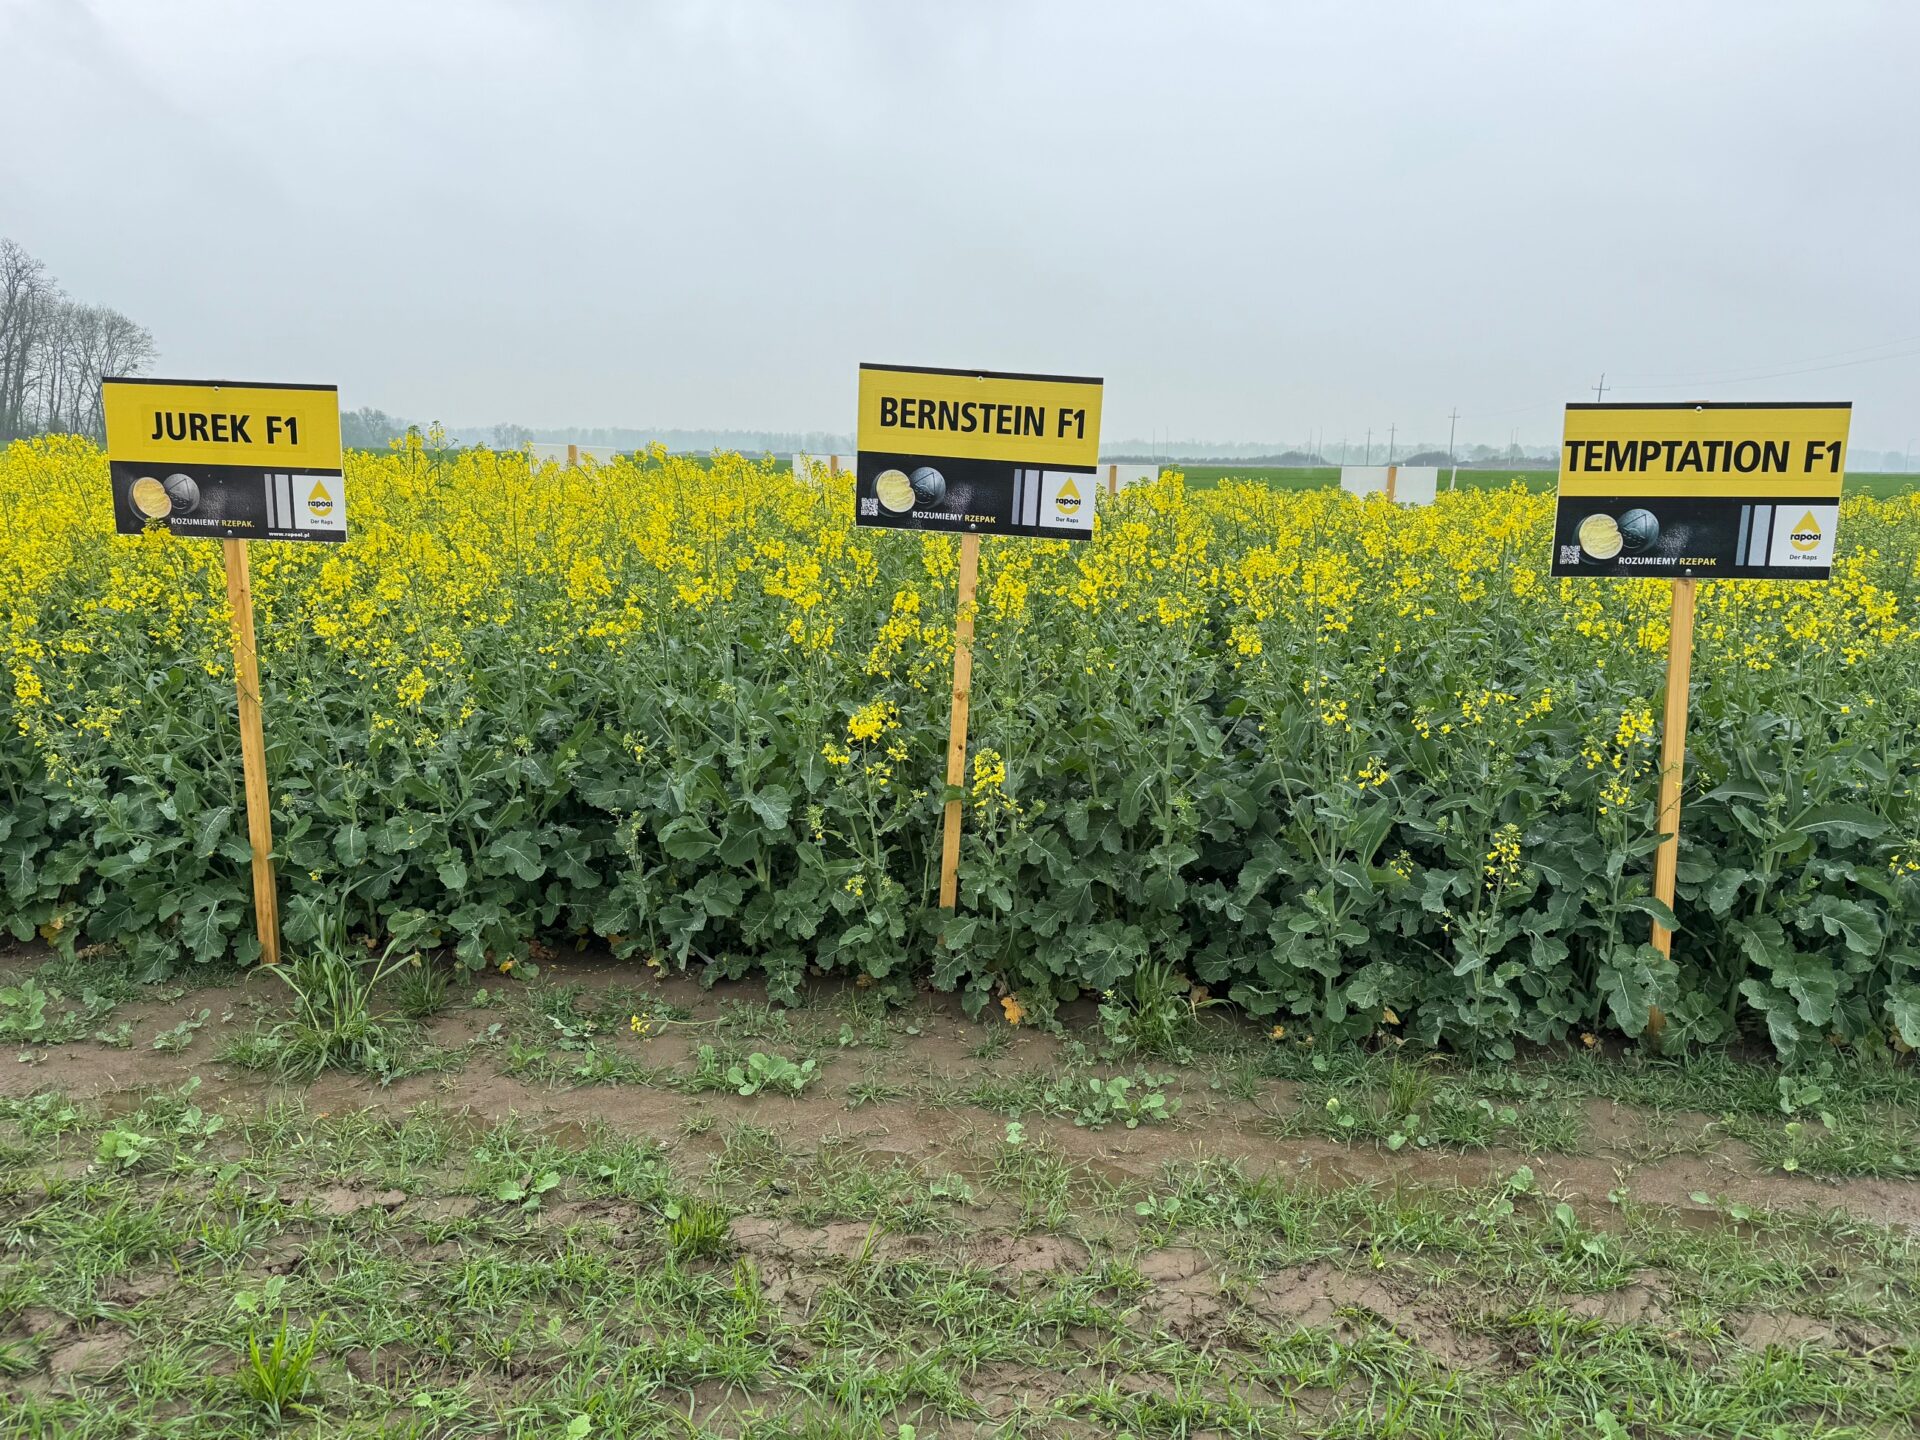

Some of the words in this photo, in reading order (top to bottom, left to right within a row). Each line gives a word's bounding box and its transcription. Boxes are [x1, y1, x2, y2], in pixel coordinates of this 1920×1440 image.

[880, 396, 1045, 437] BERNSTEIN
[1057, 408, 1086, 439] F1
[151, 411, 252, 443] JUREK
[266, 415, 298, 445] F1
[1564, 440, 1790, 473] TEMPTATION
[1803, 440, 1842, 473] F1
[307, 499, 333, 510] rapool
[1055, 497, 1082, 506] rapool
[912, 511, 963, 522] ROZUMIEMY
[964, 514, 996, 523] RZEPAK
[1066, 517, 1079, 525] Raps
[170, 517, 219, 527] ROZUMIEMY
[221, 519, 255, 528] RZEPAK.
[268, 531, 310, 539] www.rapool.pl
[1790, 532, 1822, 542] rapool
[1618, 556, 1678, 566] ROZUMIEMY
[1679, 557, 1717, 566] RZEPAK
[1789, 553, 1800, 561] Der
[1801, 554, 1818, 562] Raps
